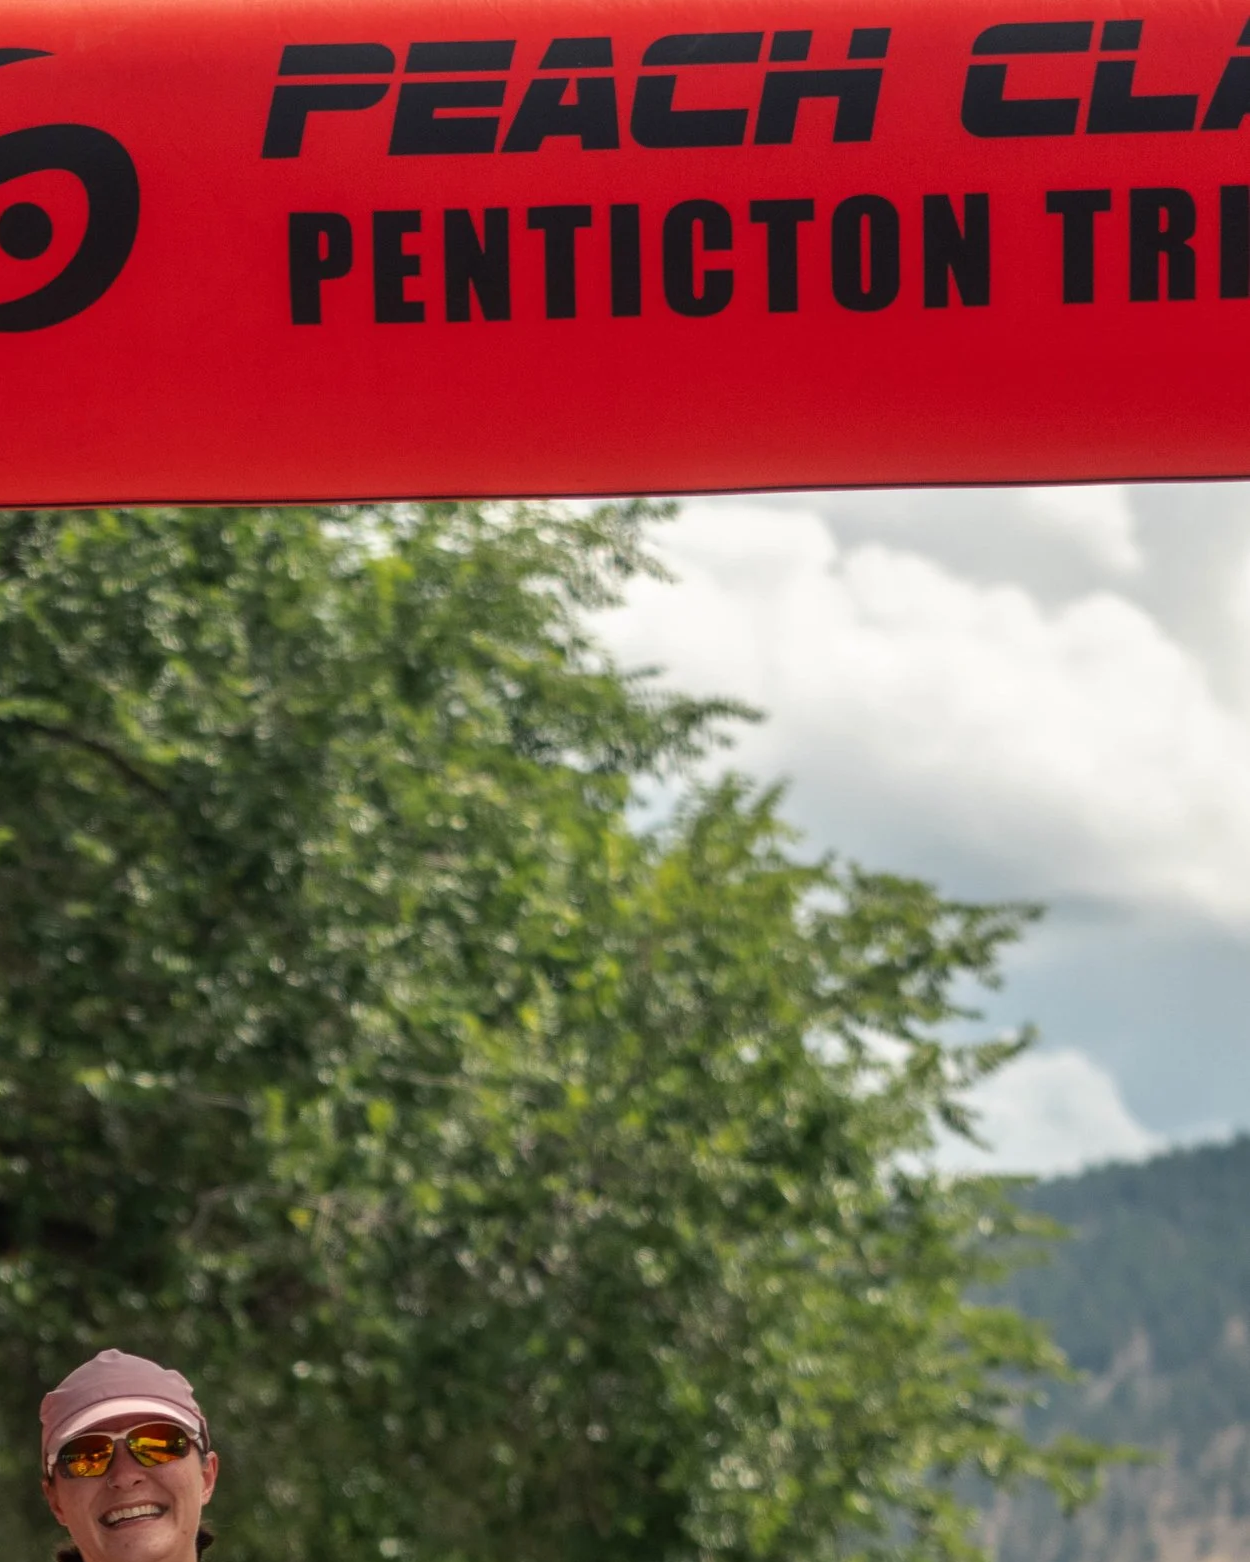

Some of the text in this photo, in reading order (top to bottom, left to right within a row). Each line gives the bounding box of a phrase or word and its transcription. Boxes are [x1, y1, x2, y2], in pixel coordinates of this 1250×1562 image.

[262, 28, 891, 159] PEACH
[289, 185, 1250, 325] PENTICTON TRI
